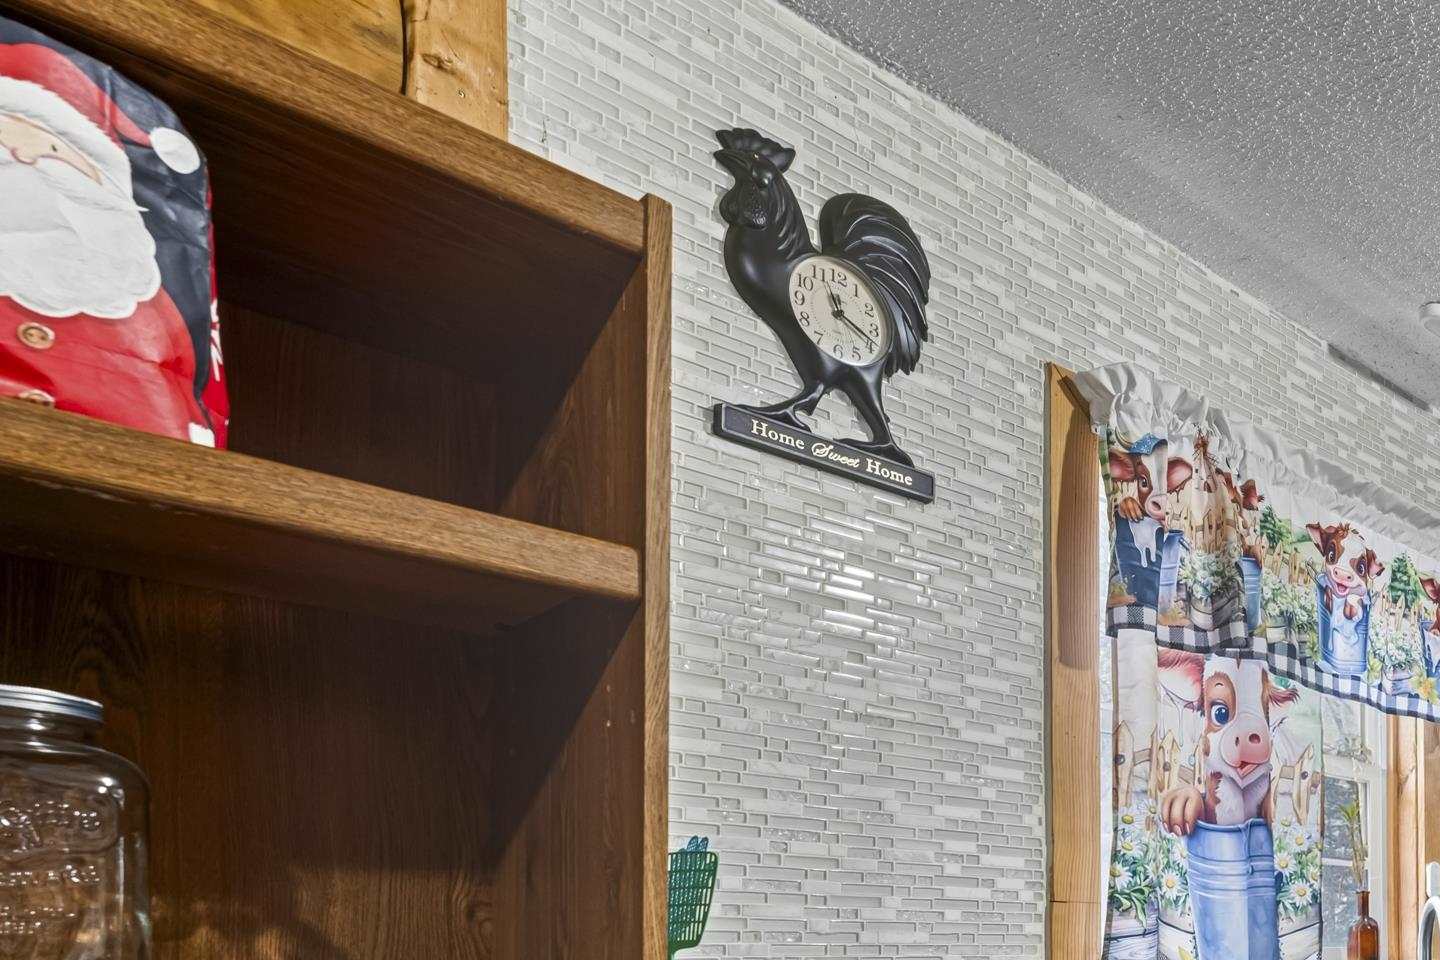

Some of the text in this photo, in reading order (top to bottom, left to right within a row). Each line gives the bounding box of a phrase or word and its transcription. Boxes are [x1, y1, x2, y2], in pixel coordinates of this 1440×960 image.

[811, 264, 826, 282] 11
[827, 268, 848, 288] 12
[795, 273, 814, 292] 10
[795, 290, 805, 306] 9
[852, 283, 861, 299] 1
[864, 302, 875, 318] 2
[799, 311, 810, 327] 8
[813, 330, 824, 345] 7
[869, 323, 879, 338] 3
[833, 344, 843, 360] 6
[852, 345, 862, 362] 5
[750, 419, 913, 486] Home Sweet Home
